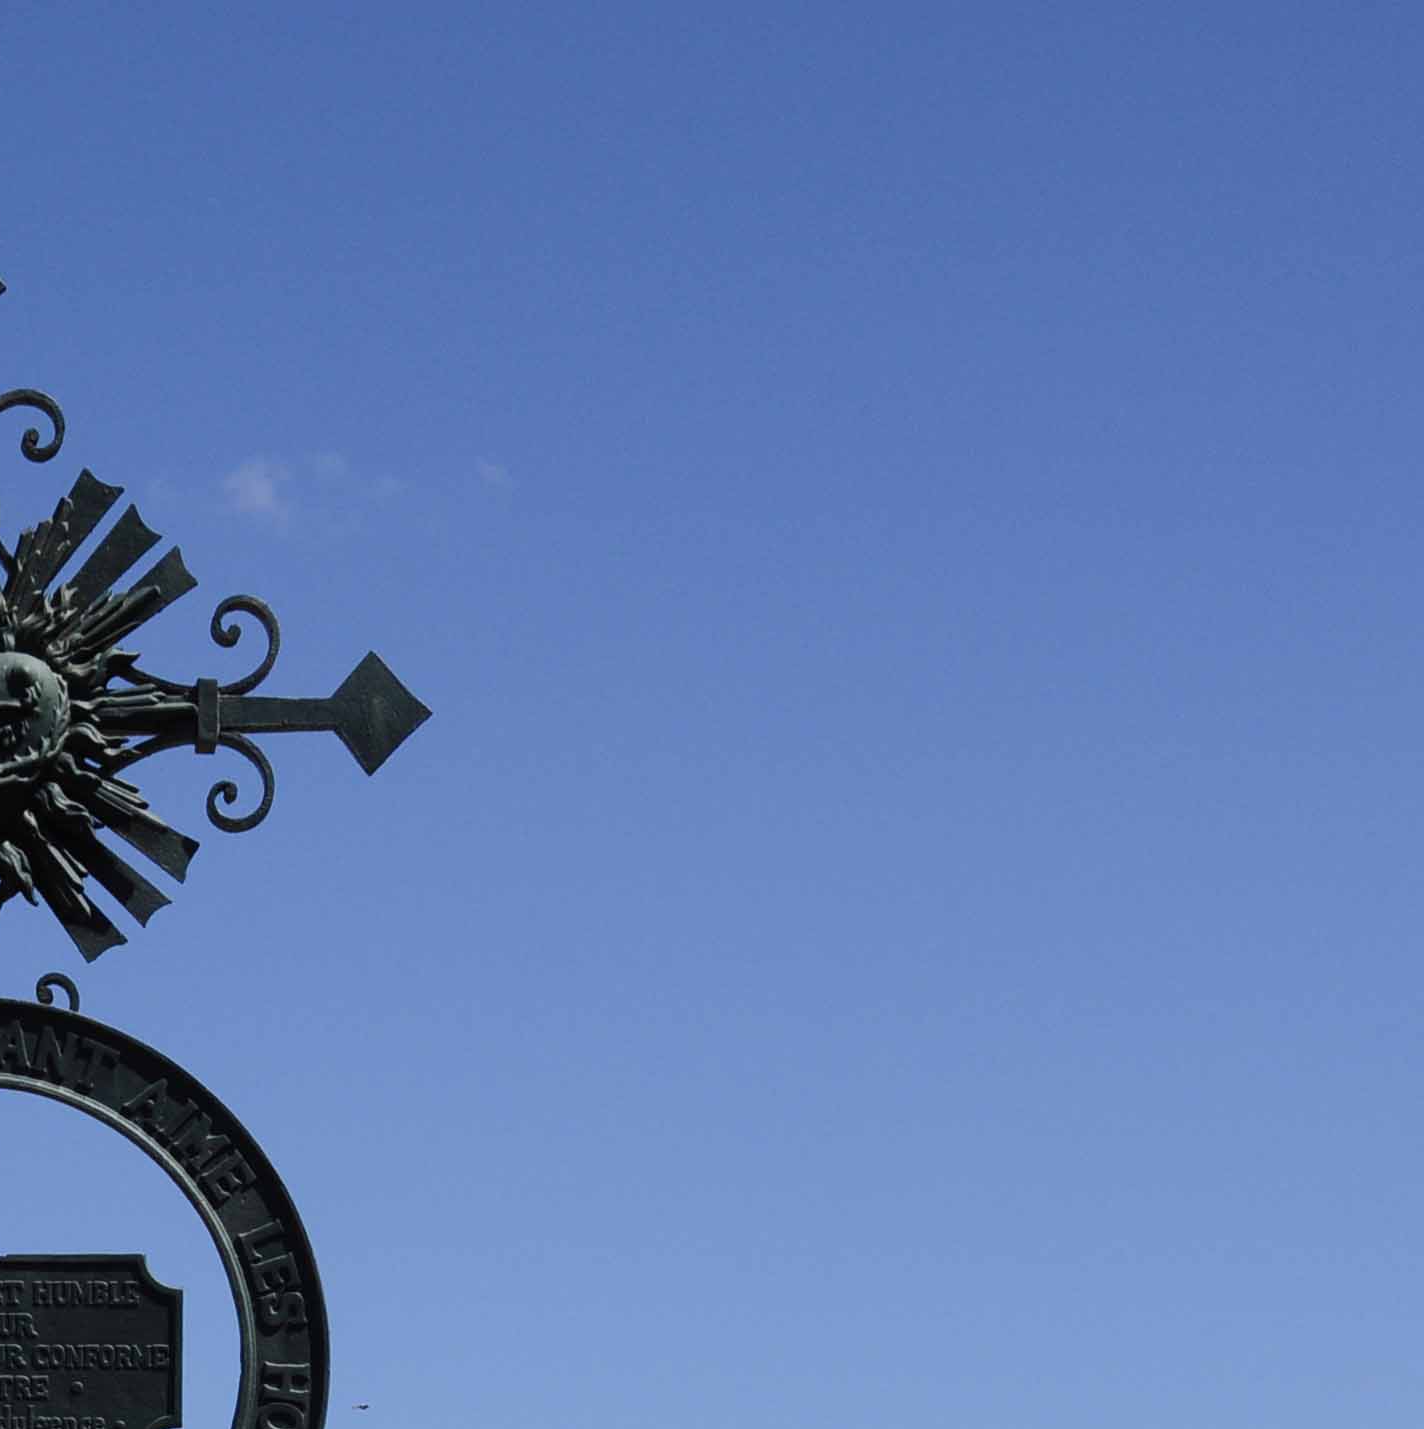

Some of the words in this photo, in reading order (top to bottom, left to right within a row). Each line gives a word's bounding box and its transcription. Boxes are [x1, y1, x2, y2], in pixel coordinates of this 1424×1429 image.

[236, 1217, 309, 1336] LES
[31, 1279, 143, 1307] HUMBLE
[32, 1342, 174, 1371] CONFORME
